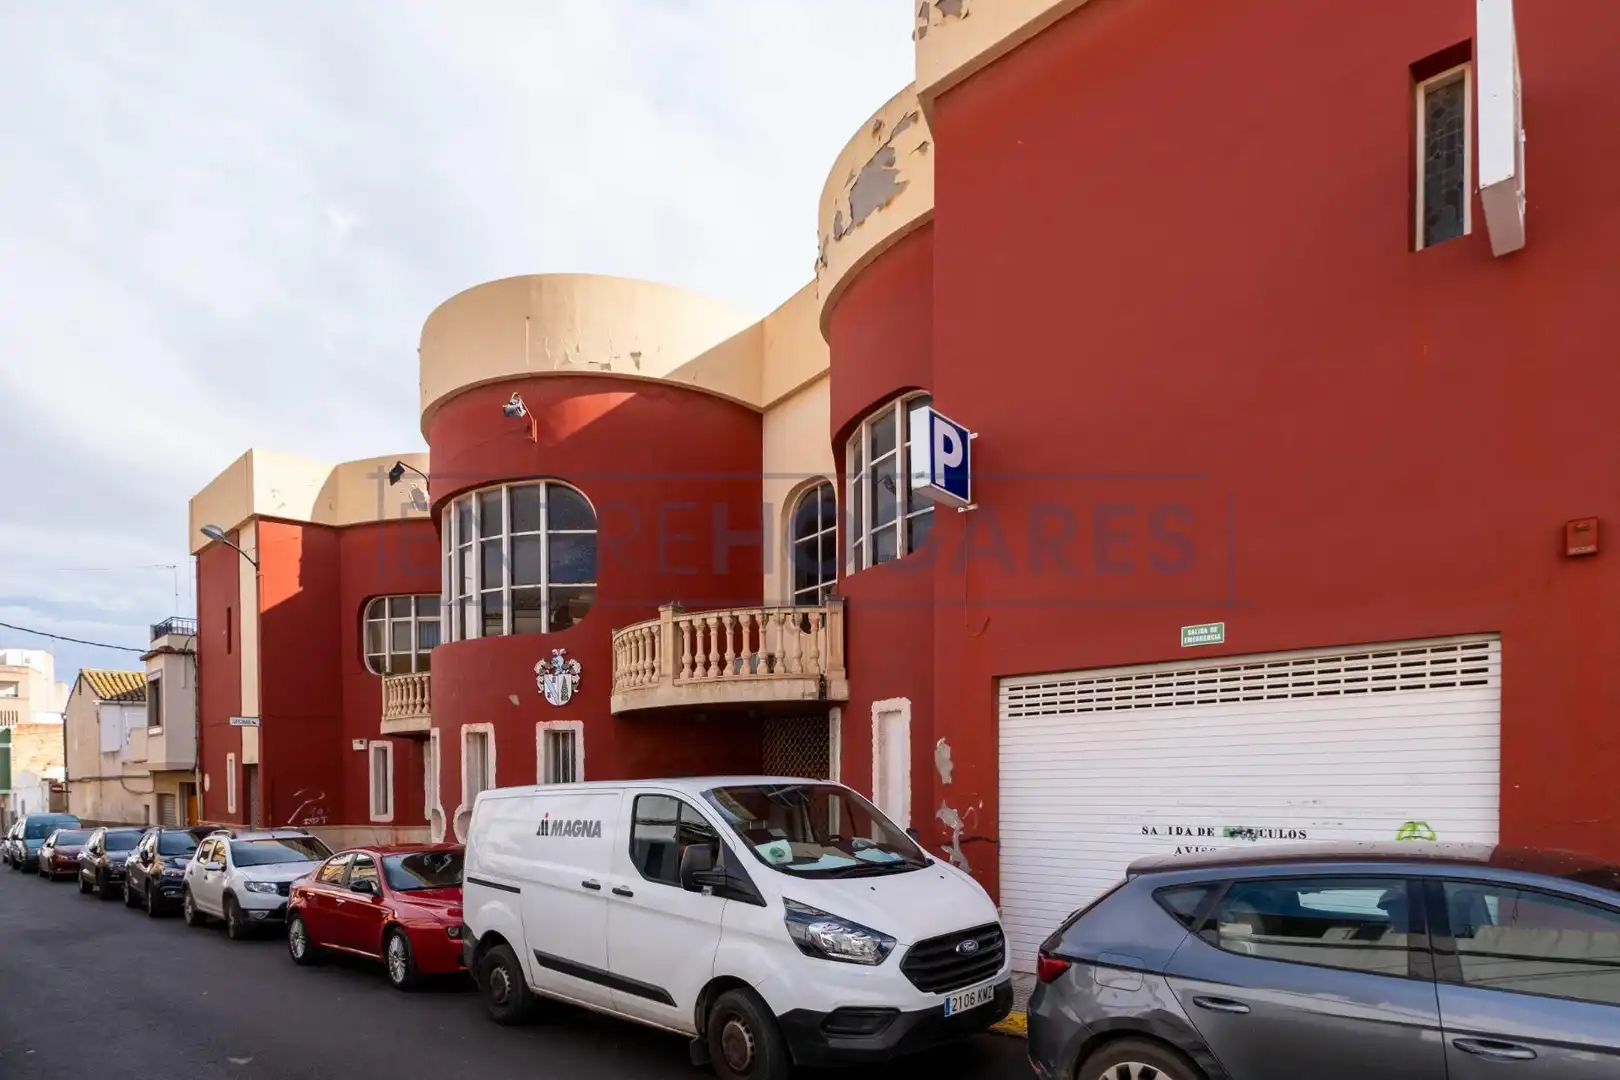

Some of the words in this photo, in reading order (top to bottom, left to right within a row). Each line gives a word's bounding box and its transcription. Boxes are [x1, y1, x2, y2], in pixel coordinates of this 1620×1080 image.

[934, 416, 963, 488] P
[550, 819, 602, 838] MAGNA
[1141, 826, 1193, 836] SAIDA
[1197, 827, 1215, 836] DE
[952, 992, 976, 1012] 2106
